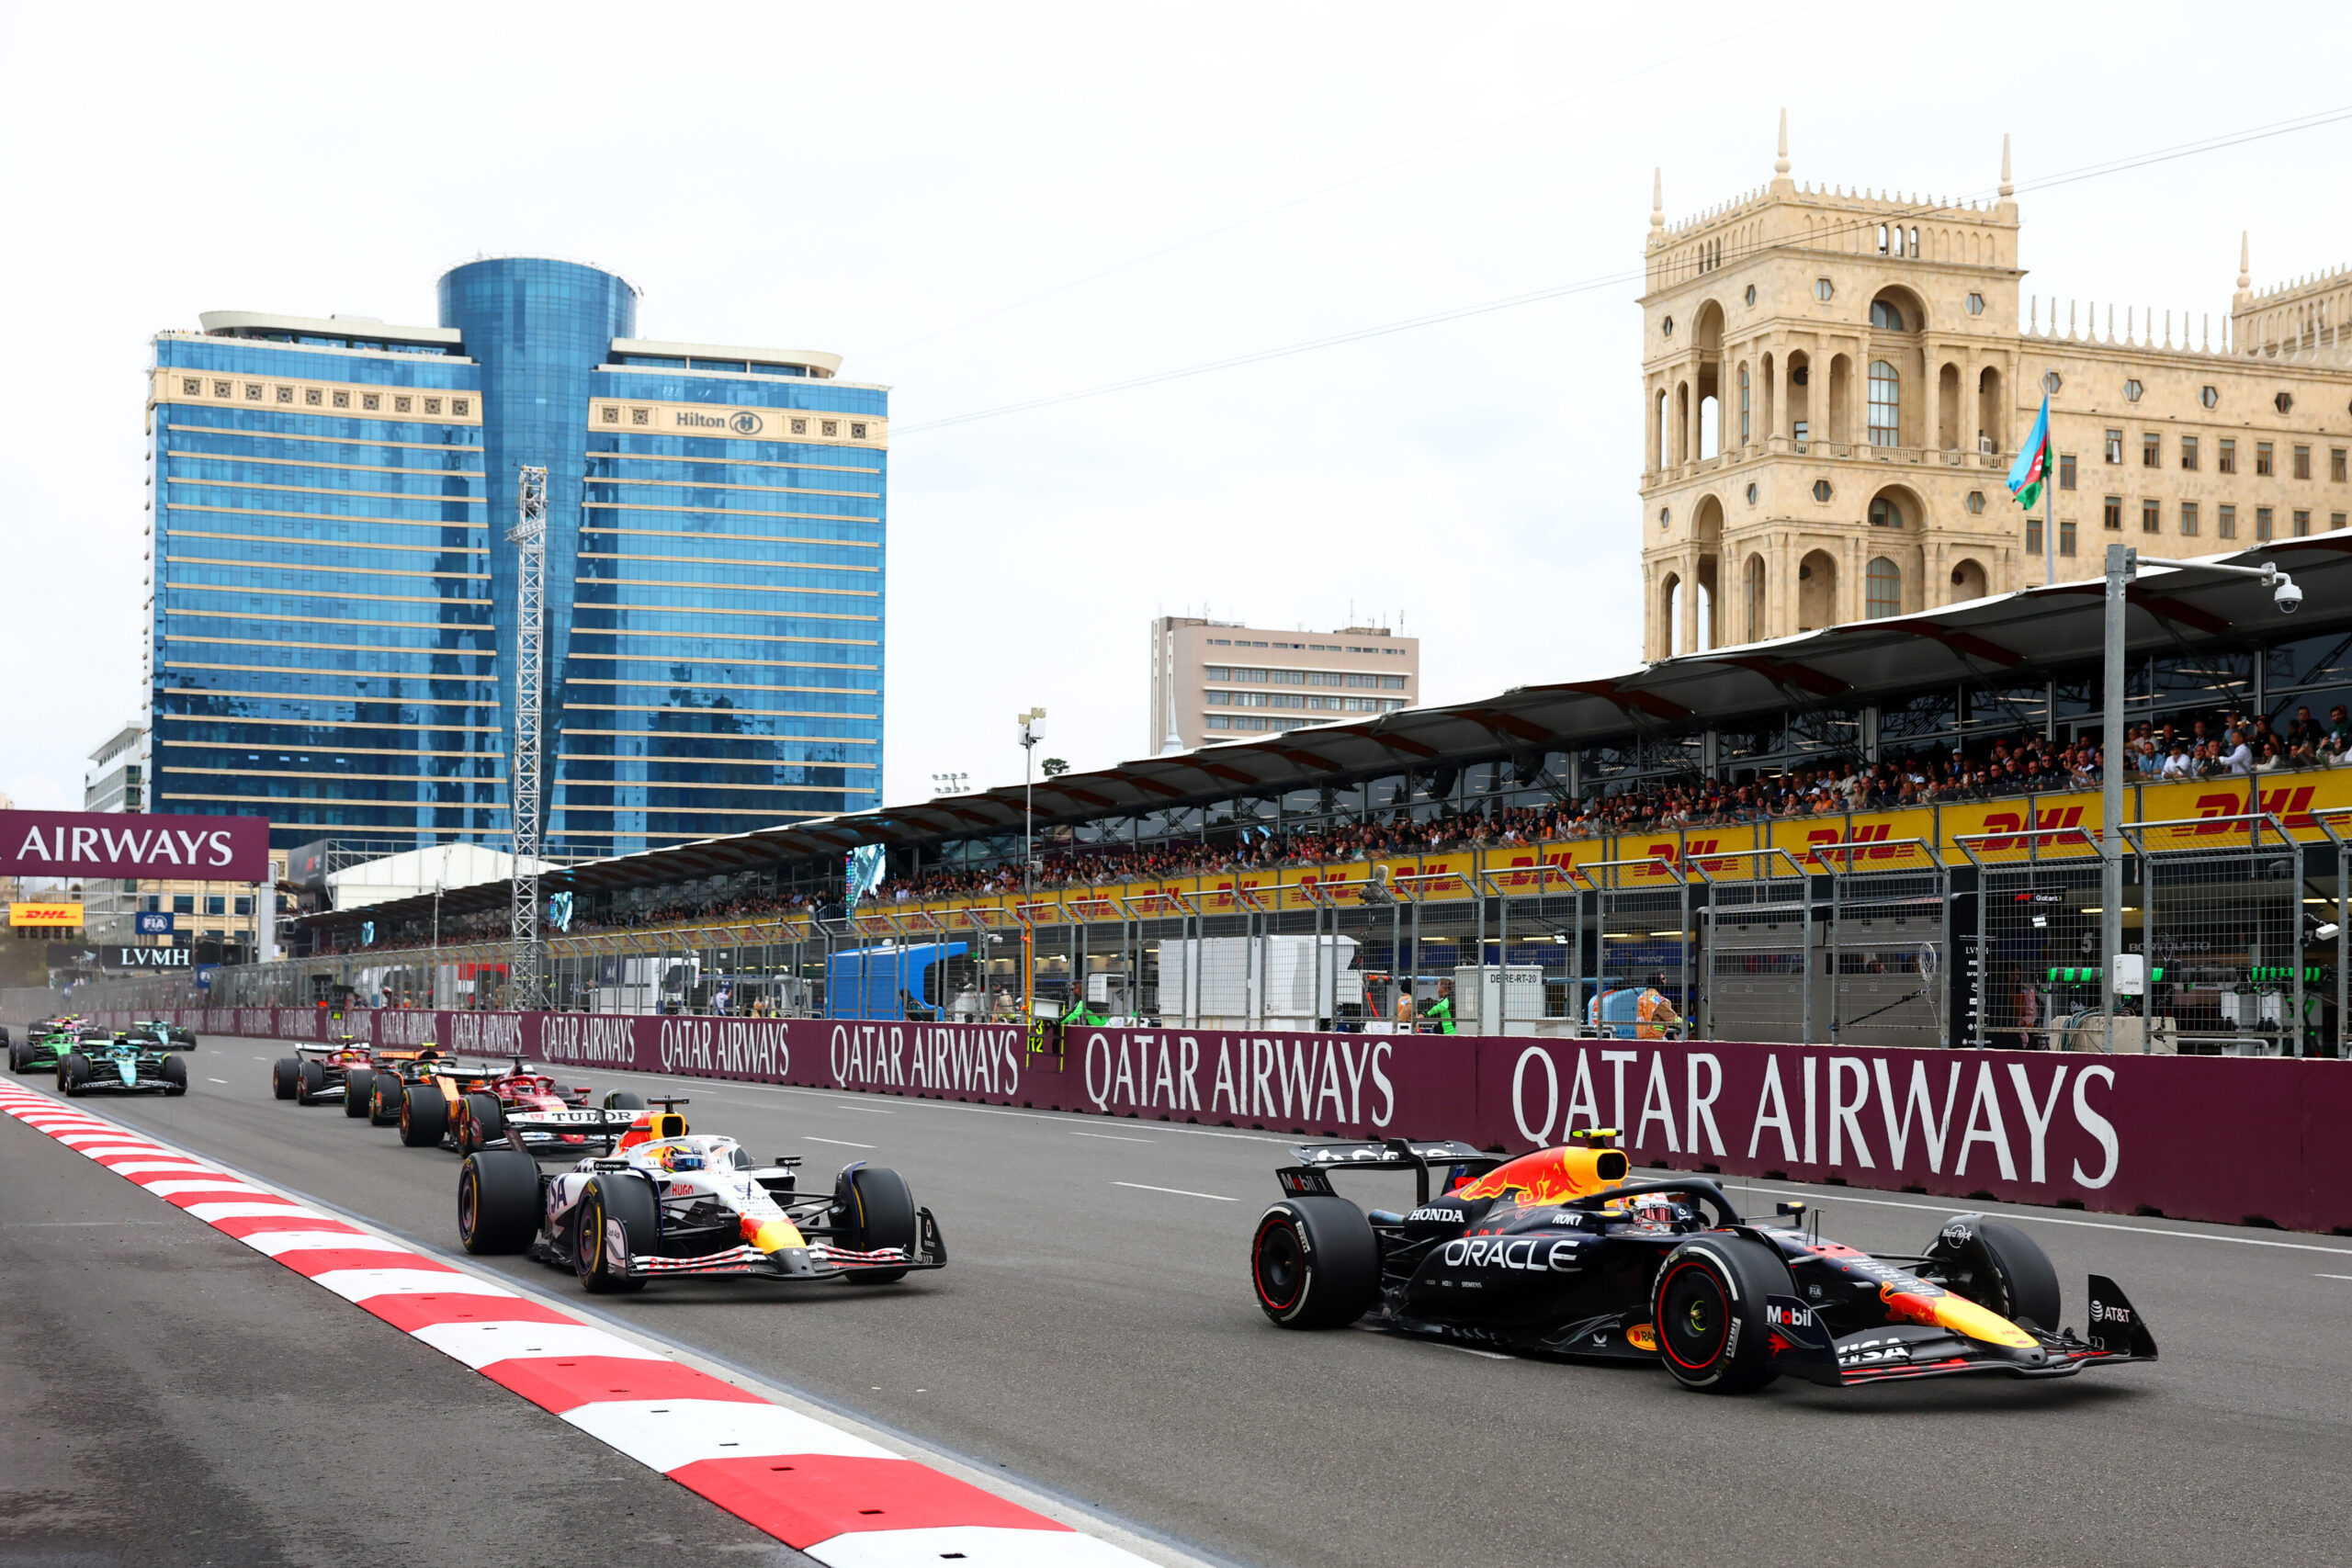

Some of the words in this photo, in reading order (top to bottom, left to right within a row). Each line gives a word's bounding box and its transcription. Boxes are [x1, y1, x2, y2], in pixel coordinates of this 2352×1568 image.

[676, 412, 725, 428] Hilton
[2194, 786, 2324, 837] DHL
[1982, 807, 2087, 852] DHL
[16, 825, 233, 866] AIRWAYS
[1647, 840, 1724, 875] DHL
[1806, 824, 1897, 864] DHL
[1395, 864, 1451, 894] DHL
[1510, 852, 1577, 886] DHL
[1143, 887, 1181, 912] DHL
[1217, 881, 1259, 907] DHL
[1300, 874, 1351, 902] DHL
[26, 910, 67, 919] DHL
[121, 949, 189, 965] LVMH
[1490, 975, 1536, 983] DERE-RT-20
[541, 1015, 578, 1061] QATAR
[582, 1018, 635, 1063] AIRWAYS
[1035, 1020, 1044, 1034] 3
[661, 1019, 711, 1072] QATAR
[716, 1021, 789, 1076] AIRWAYS
[831, 1024, 905, 1088] QATAR
[910, 1027, 1019, 1096] AIRWAYS
[1085, 1032, 1201, 1111] QATAR
[1211, 1036, 1394, 1127] AIRWAYS
[552, 1111, 633, 1122] TUDOR
[1512, 1045, 1727, 1157] QATAR
[1748, 1054, 2120, 1190] AIRWAYS
[672, 1183, 694, 1196] HUGO
[1280, 1173, 1317, 1191] Mobil
[1408, 1208, 1465, 1224] HONDA
[1941, 1228, 1957, 1238] Hard
[1444, 1239, 1582, 1272] ORACLE
[1767, 1305, 1812, 1326] Mobil
[2104, 1306, 2131, 1324] AT&T
[1725, 1316, 1741, 1359] PIRELLI
[1838, 1337, 1910, 1362] VISA
